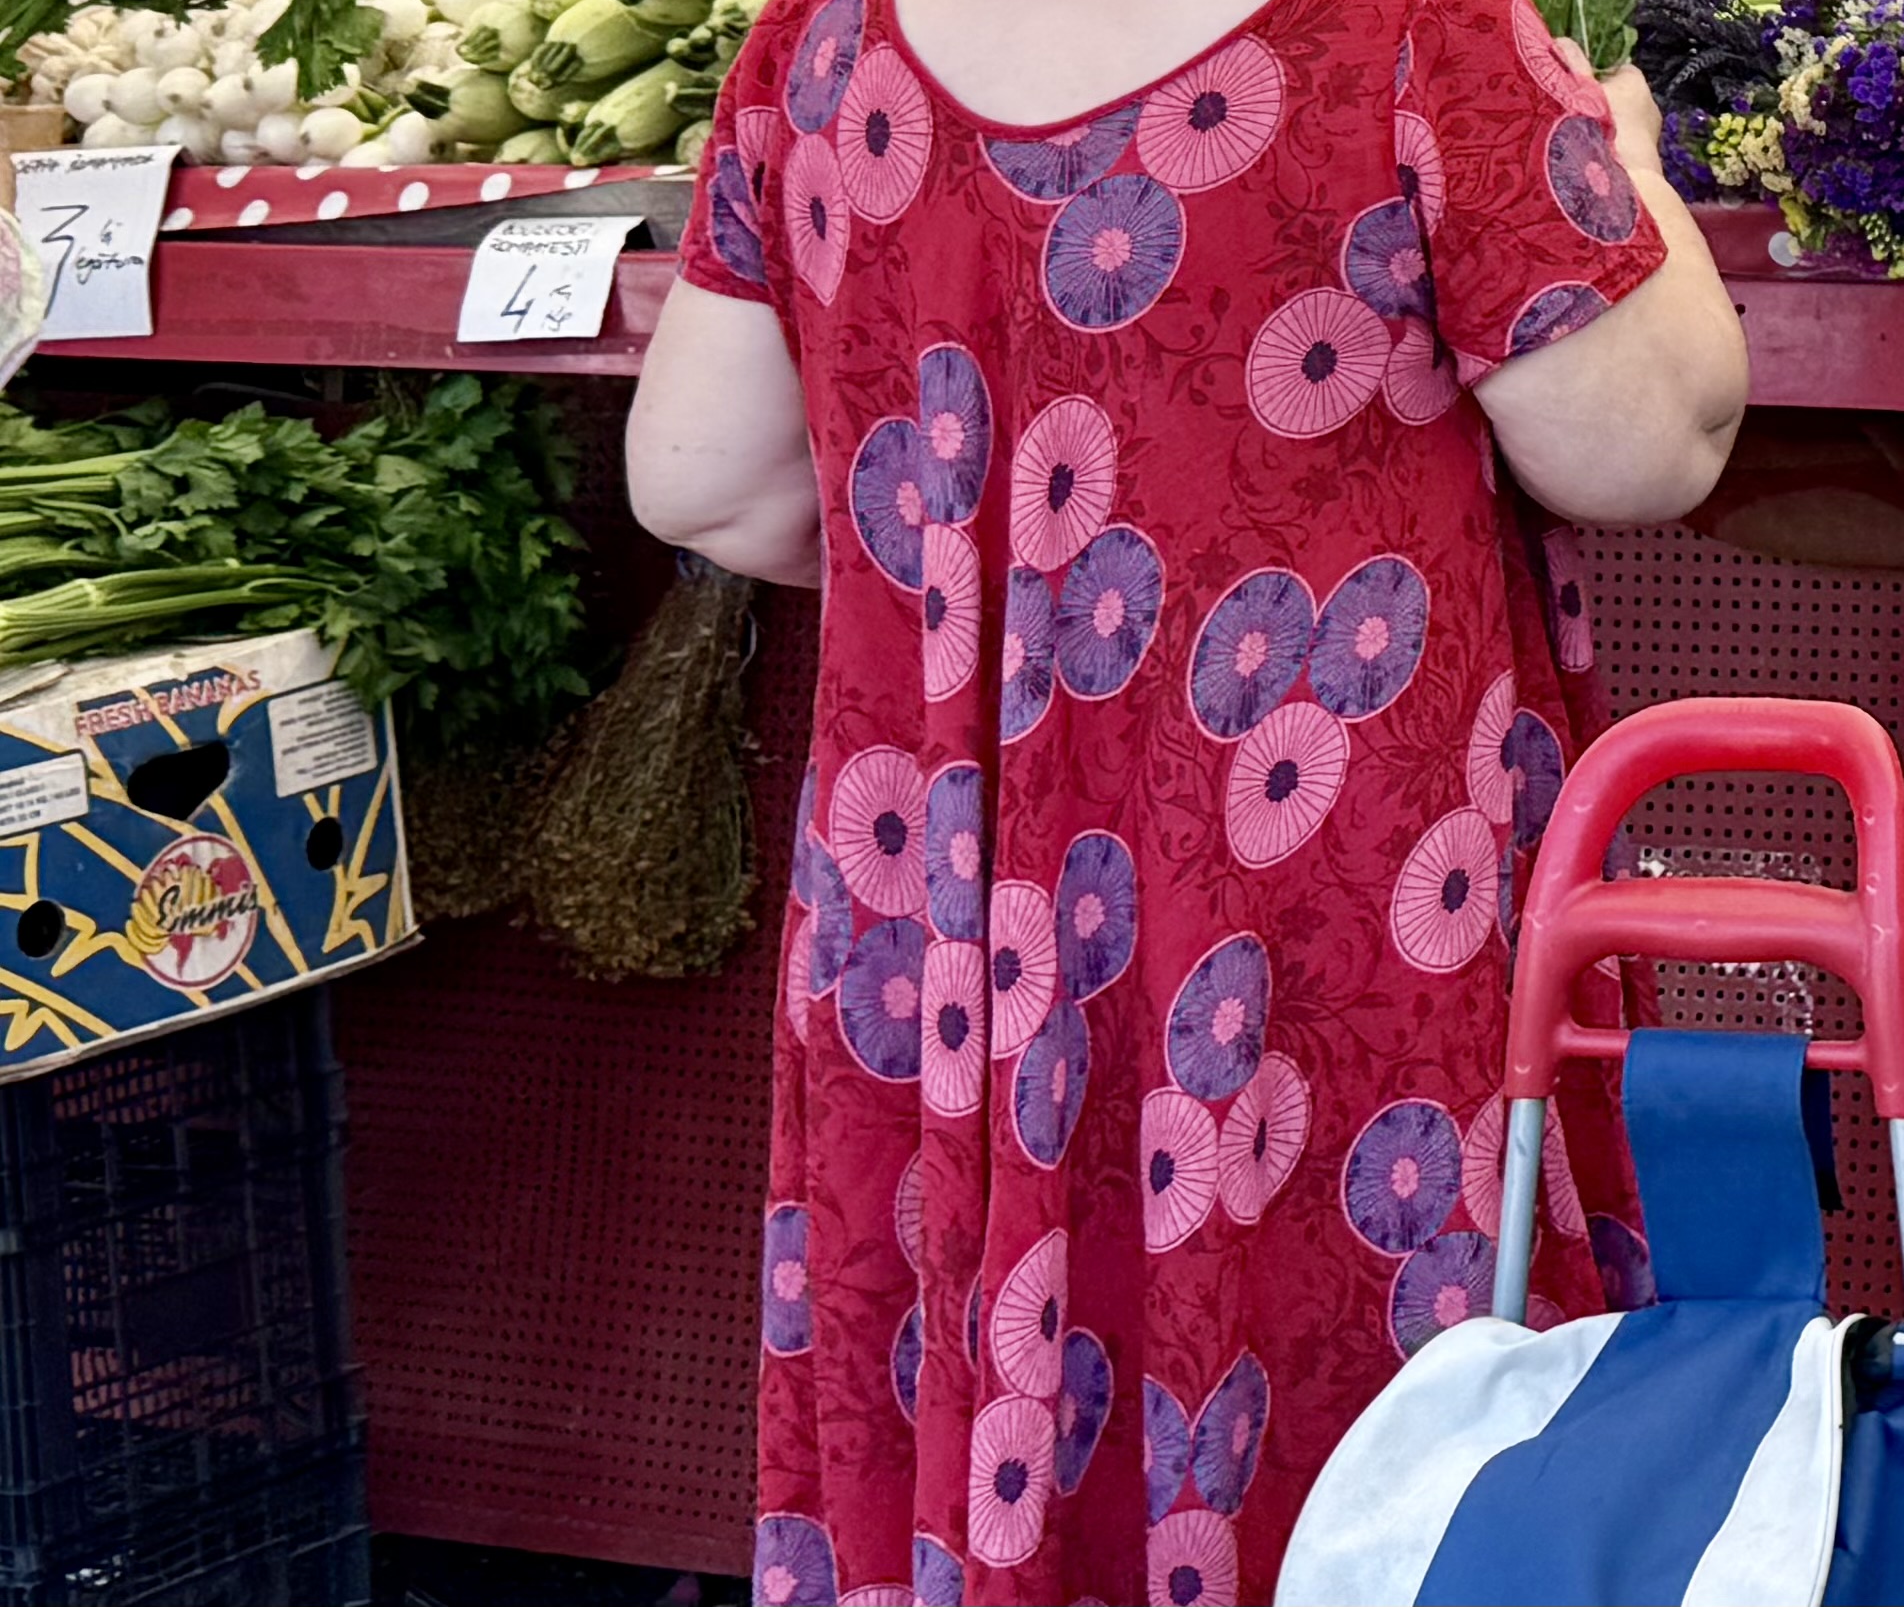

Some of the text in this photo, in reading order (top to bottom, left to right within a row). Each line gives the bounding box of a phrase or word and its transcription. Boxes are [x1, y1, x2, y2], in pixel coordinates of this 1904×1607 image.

[500, 264, 537, 334] 4
[75, 670, 262, 735] FRESH BANANAS
